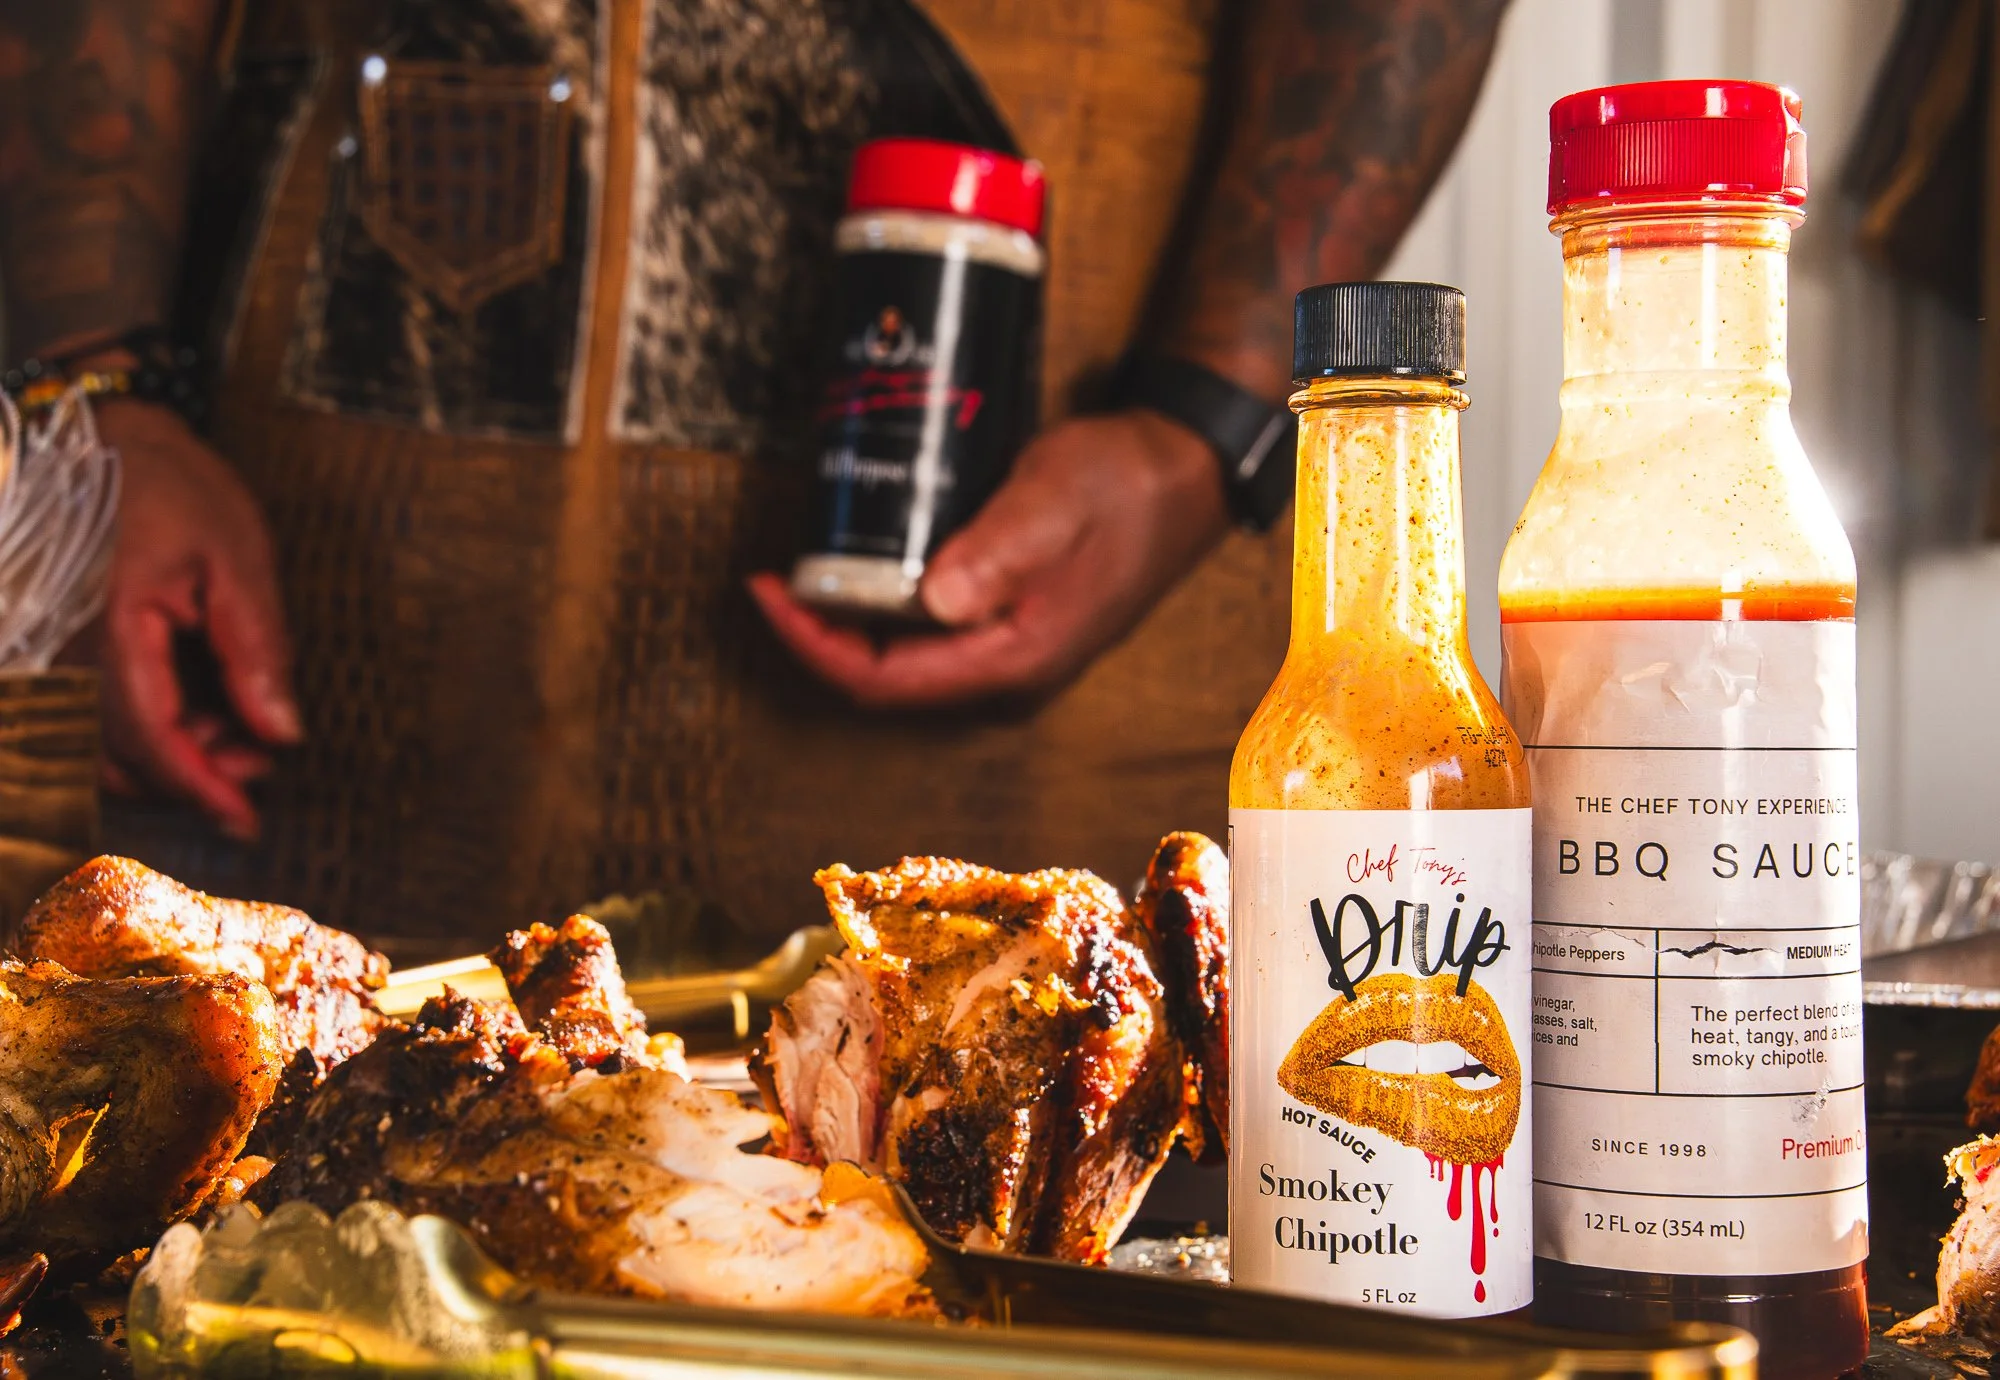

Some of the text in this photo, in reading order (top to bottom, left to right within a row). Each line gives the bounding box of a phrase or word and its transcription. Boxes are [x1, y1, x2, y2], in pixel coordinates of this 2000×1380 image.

[1575, 796, 1847, 815] THE CHEF TONY EXPERIENCE
[1346, 844, 1467, 885] Chef Tony's
[1559, 839, 1854, 882] BBQ SAUCE
[1310, 893, 1510, 1001] Drip
[1532, 942, 1625, 962] hipotle Peppers
[1787, 945, 1832, 960] MEDIUM
[1533, 994, 1575, 1012] vinegar,
[1532, 1013, 1598, 1032] lasses, salt,
[1691, 1005, 1727, 1022] The
[1736, 1004, 1798, 1026] perfect
[1803, 1004, 1838, 1020] blend
[1532, 1031, 1578, 1046] ices and
[1691, 1028, 1740, 1047] heat,
[1747, 1028, 1799, 1047] tangy,
[1803, 1025, 1828, 1042] and
[1831, 1028, 1837, 1040] a
[1692, 1048, 1828, 1070] smoky chipotle.
[1281, 1106, 1376, 1164] HOT SAUCE
[1591, 1138, 1707, 1158] SINCE 1998
[1782, 1134, 1854, 1160] Premium
[1259, 1162, 1394, 1215] Smokey
[1584, 1212, 1745, 1240] 12 FL oz (354 mL)
[1274, 1215, 1419, 1265] Chipotle
[1361, 1288, 1417, 1304] 5 FL oz
